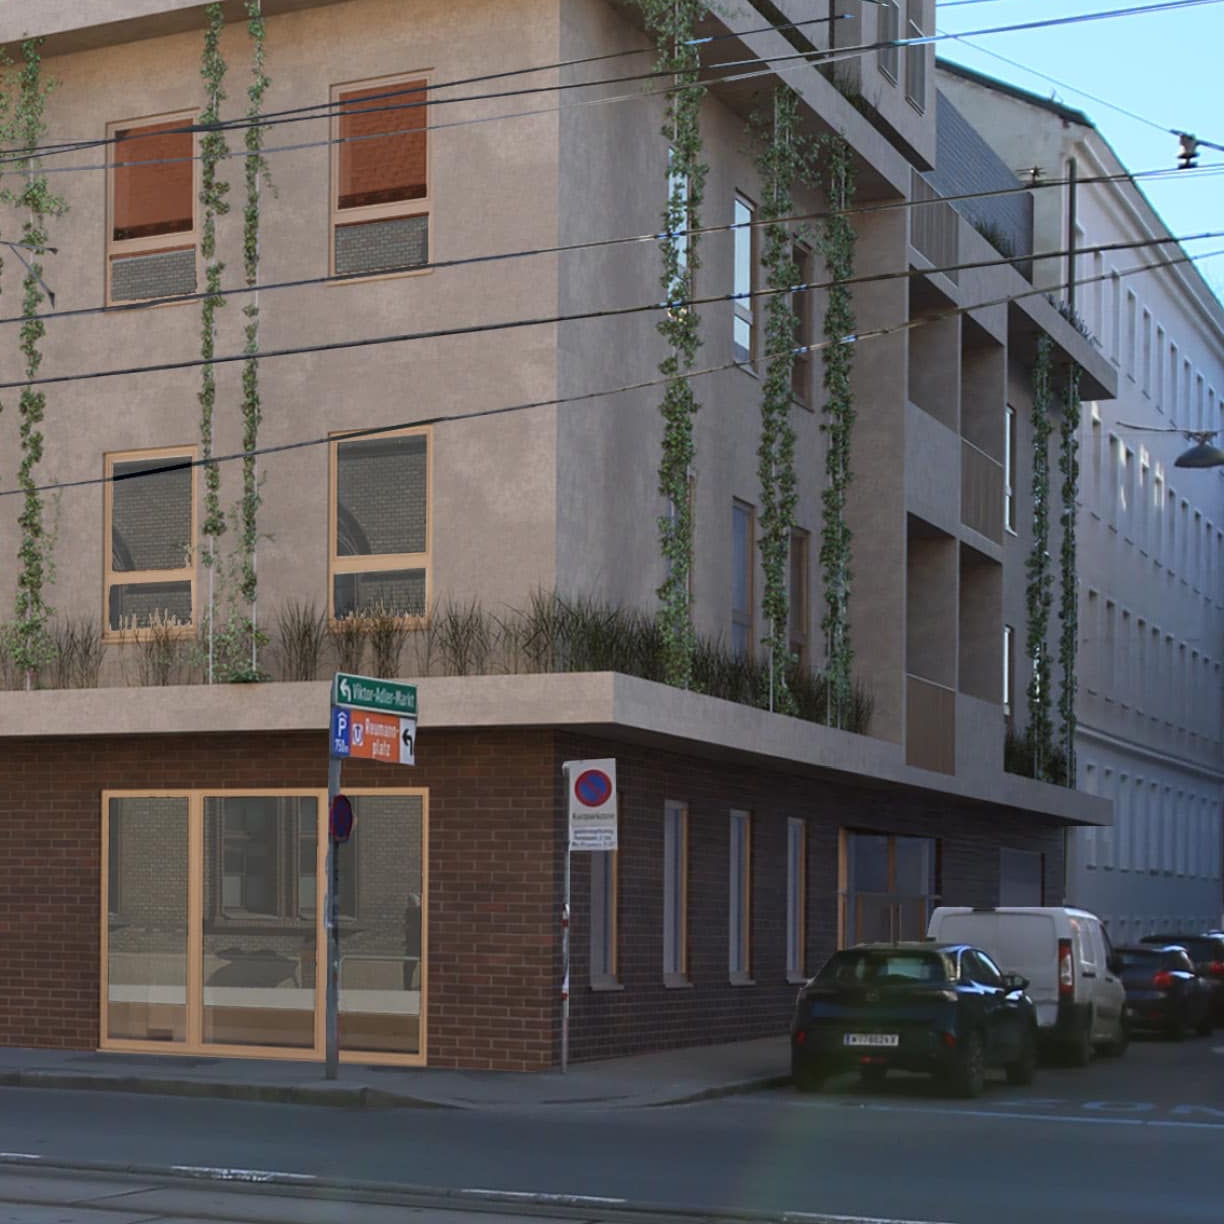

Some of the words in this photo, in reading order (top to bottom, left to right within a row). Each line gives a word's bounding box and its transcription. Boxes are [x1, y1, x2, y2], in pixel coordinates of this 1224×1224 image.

[352, 683, 415, 708] Viktor-Adler-Markt
[338, 717, 347, 737] P
[372, 740, 391, 759] platz
